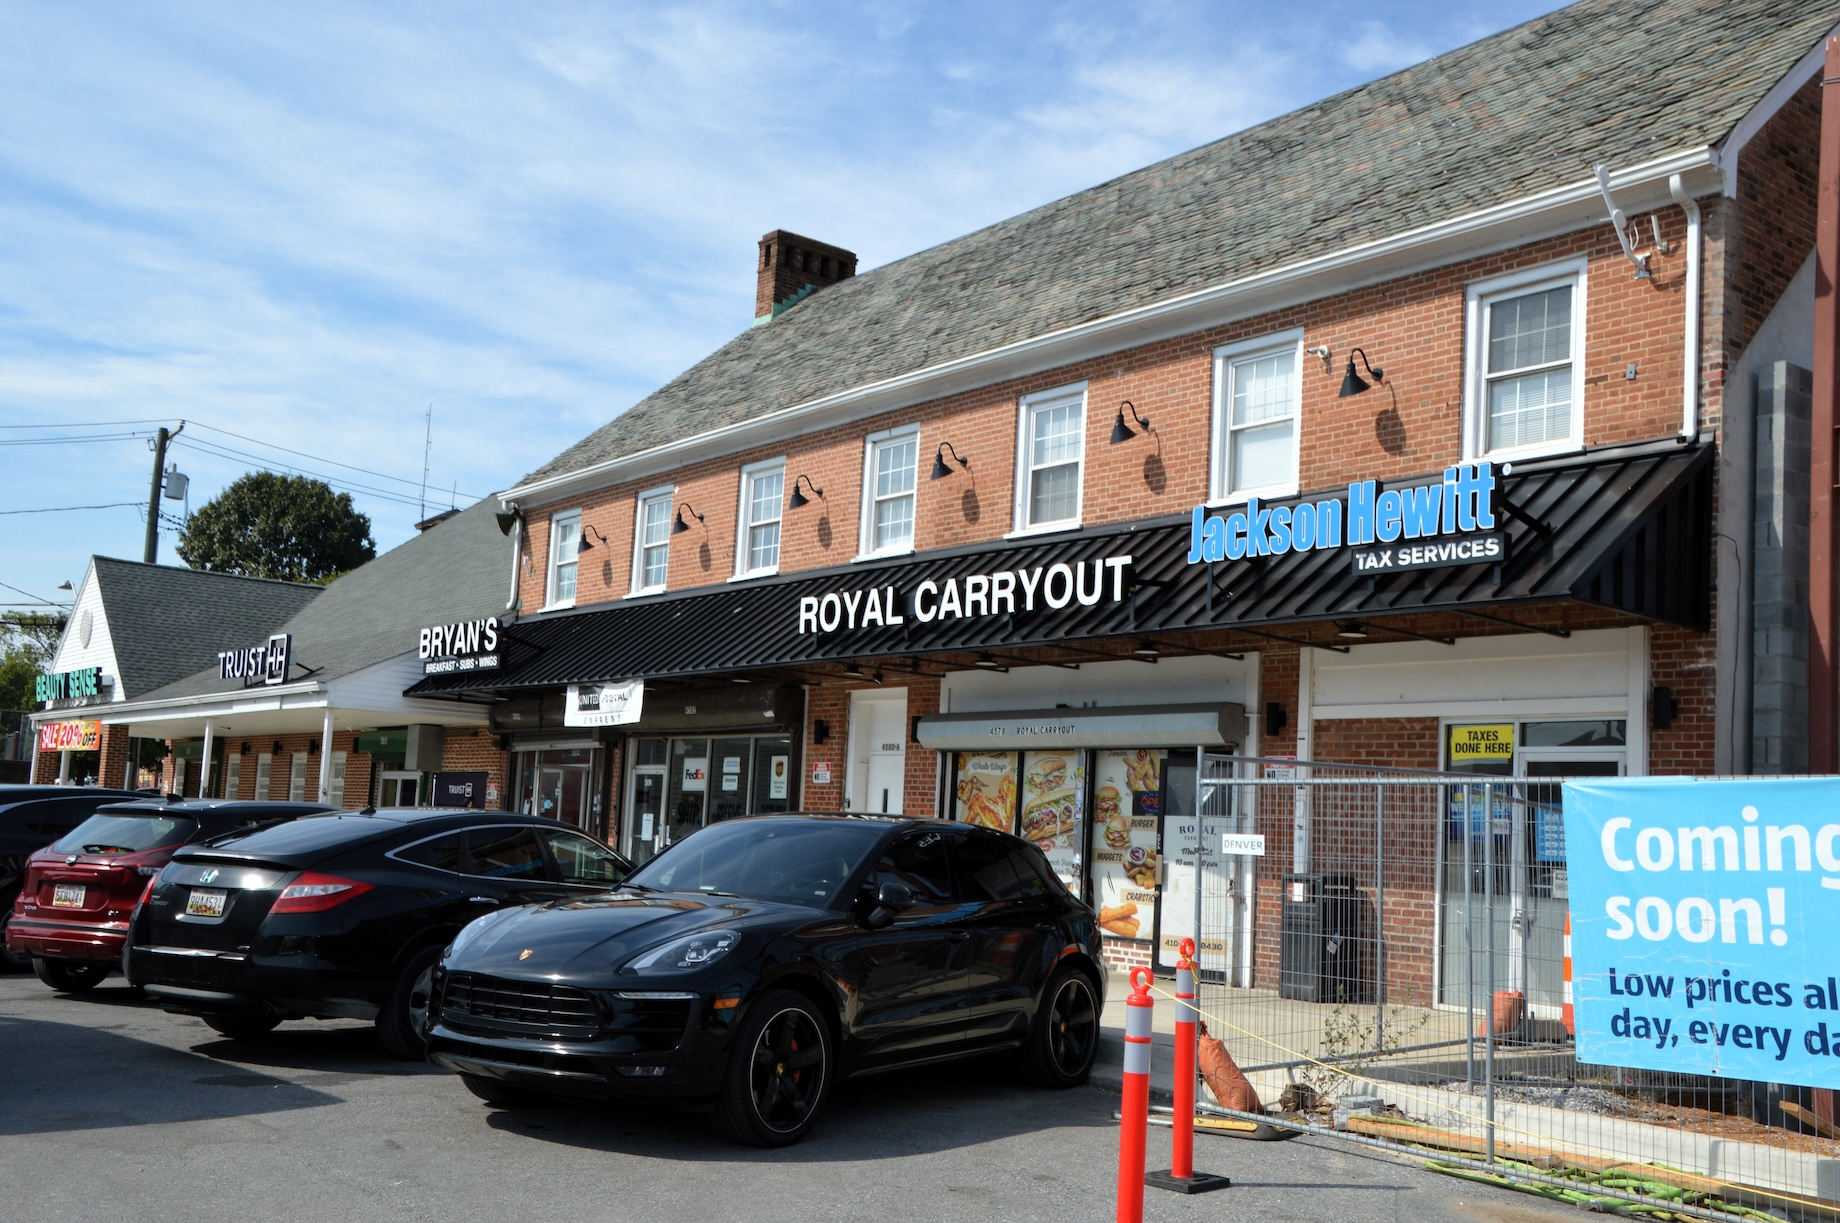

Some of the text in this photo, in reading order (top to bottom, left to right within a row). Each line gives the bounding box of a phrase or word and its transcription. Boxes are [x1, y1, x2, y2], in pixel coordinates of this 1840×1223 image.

[1187, 462, 1495, 564] Jackson Hewitt
[1356, 538, 1500, 570] TAX SERVICES
[799, 555, 1132, 634] ROYAL CARRYOUT
[419, 616, 497, 659] BRYAN'S
[218, 647, 266, 680] TRUIST
[426, 656, 497, 674] BREAKFAST SUBS WINGS
[36, 667, 97, 703] BEAUTY SENSE
[578, 693, 600, 705] UNITED
[584, 714, 622, 724] EXPRESS
[41, 723, 83, 748] SALE 20%
[990, 725, 1075, 735] 4578 ROYAL CARRYOUT
[1467, 730, 1499, 741] TAXES
[82, 733, 96, 746] OFF
[1455, 743, 1511, 753] DONE HERE
[972, 761, 1007, 773] Whole Wings
[685, 769, 705, 780] FedEx
[448, 785, 465, 794] TRUIST
[1141, 797, 1159, 808] OPE
[1131, 820, 1154, 828] BURGER
[1179, 825, 1217, 836] ROAL
[1224, 839, 1263, 850] DENVER
[1097, 852, 1123, 861] NUGGETS
[1126, 892, 1155, 902] CRABSTIC
[1605, 887, 1788, 946] soon!
[1609, 967, 1840, 1010] Low prices al
[1611, 1007, 1678, 1049] day,
[1689, 1018, 1792, 1061] every
